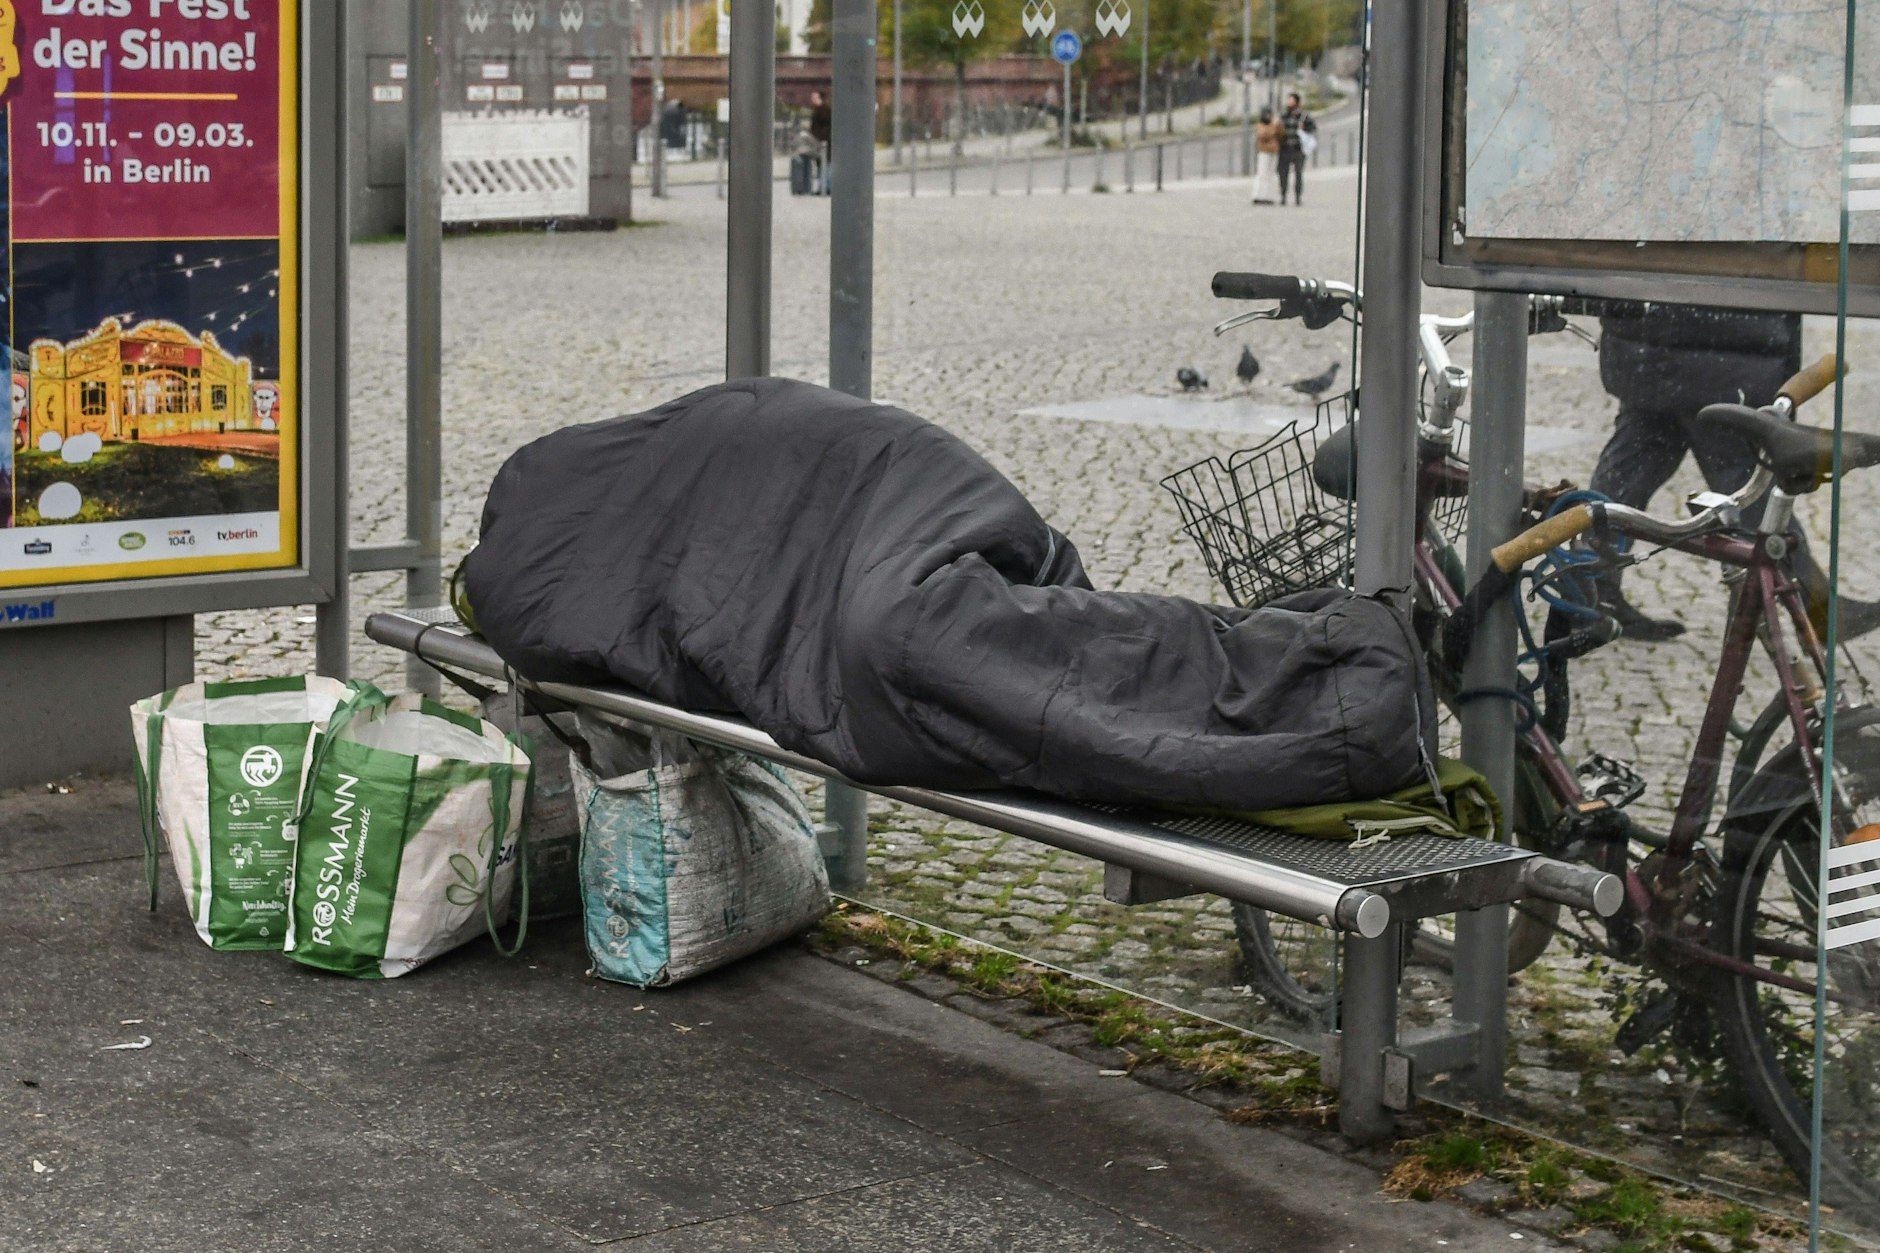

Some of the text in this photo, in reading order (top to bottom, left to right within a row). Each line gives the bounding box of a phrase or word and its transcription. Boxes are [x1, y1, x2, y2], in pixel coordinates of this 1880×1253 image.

[33, 28, 257, 71] der Sinne!
[36, 122, 118, 148] 10.11.
[154, 122, 254, 148] 09.03.
[83, 158, 211, 183] in Berlin
[168, 536, 196, 546] 104.6
[312, 773, 359, 946] ROSSMANN
[341, 806, 371, 926] Mein Drogeriemarkt
